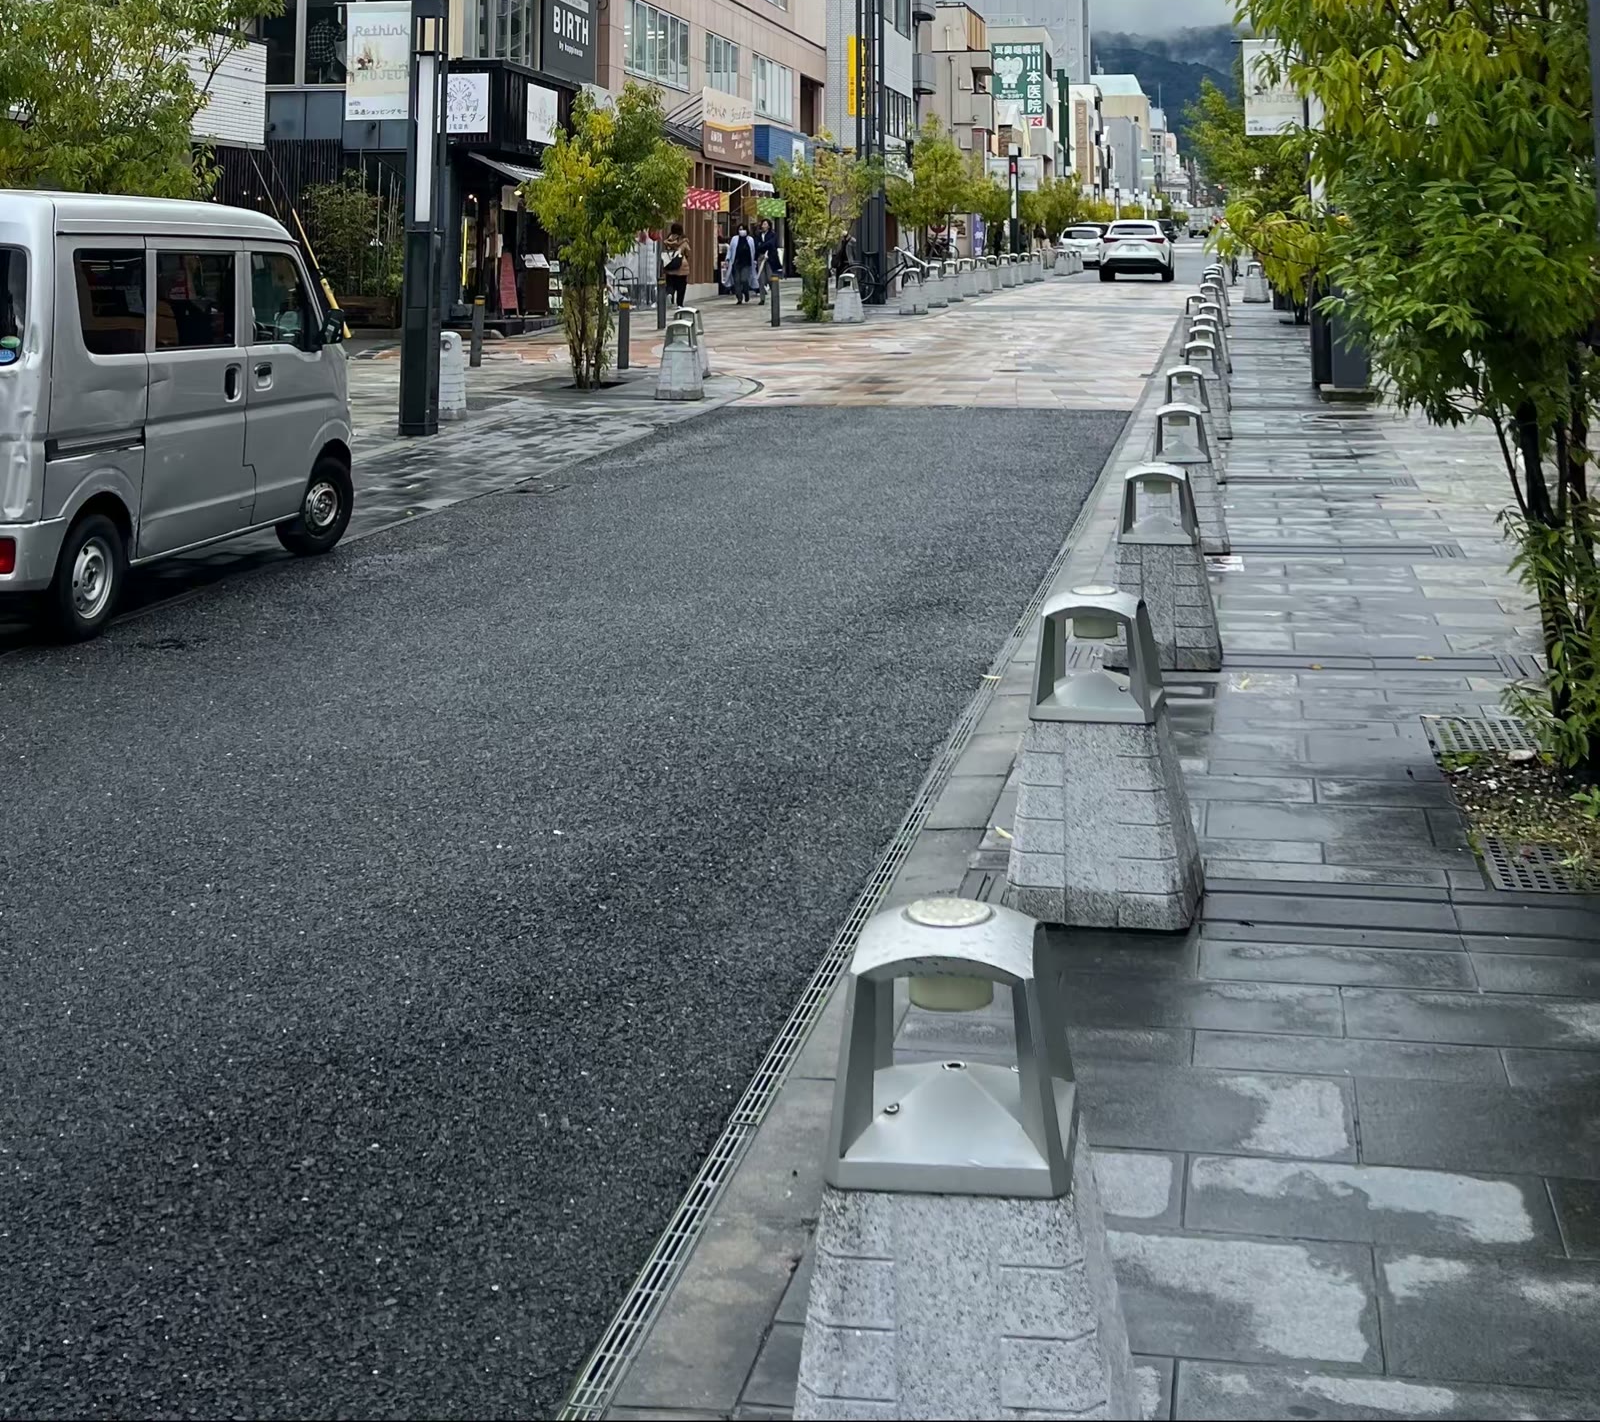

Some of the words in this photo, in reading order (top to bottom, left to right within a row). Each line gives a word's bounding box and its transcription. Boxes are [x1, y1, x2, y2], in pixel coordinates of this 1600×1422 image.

[355, 24, 408, 37] Rethink
[553, 5, 589, 46] BIRTH
[1026, 56, 1042, 113] 川本医院
